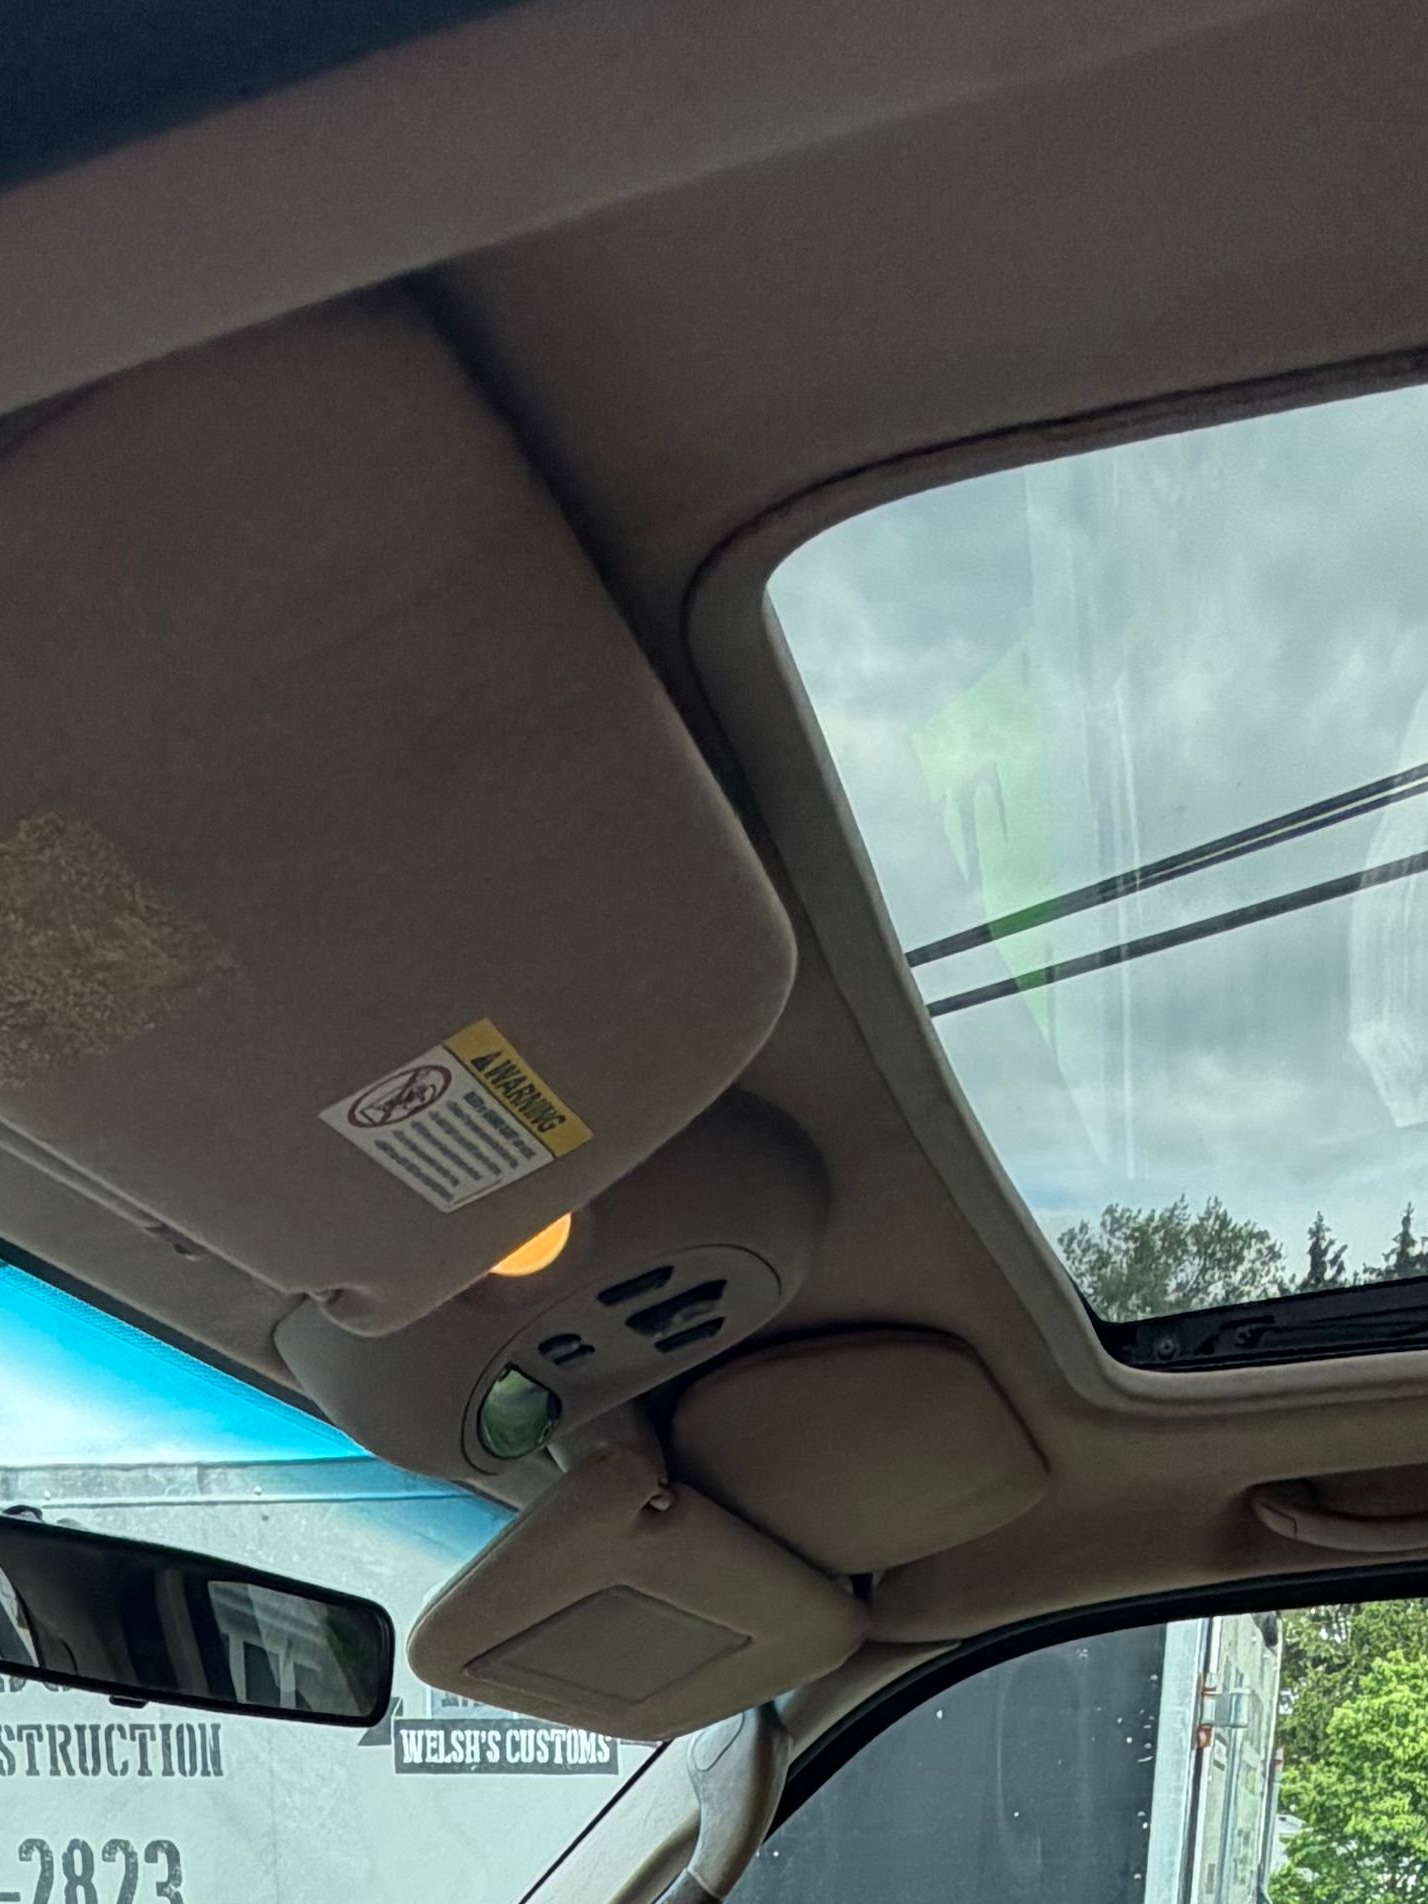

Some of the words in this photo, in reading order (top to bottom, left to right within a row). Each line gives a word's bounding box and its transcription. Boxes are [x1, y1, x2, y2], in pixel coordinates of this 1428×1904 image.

[484, 1058, 566, 1133] WARNING
[399, 1729, 499, 1764] WELSH'S
[505, 1728, 611, 1766] CUSTOMS
